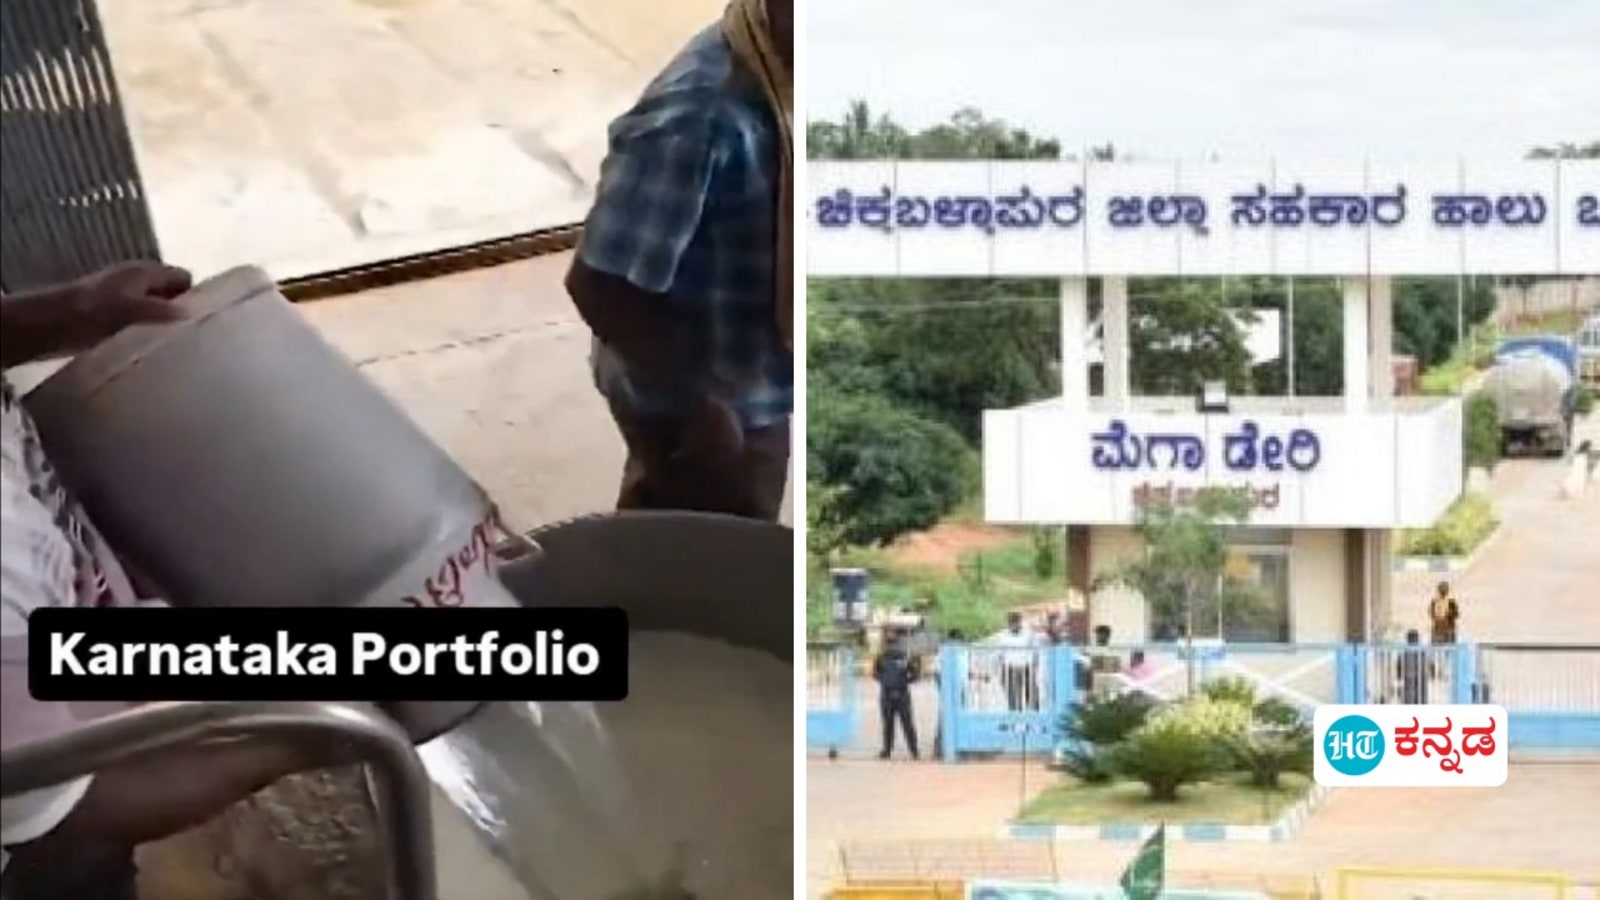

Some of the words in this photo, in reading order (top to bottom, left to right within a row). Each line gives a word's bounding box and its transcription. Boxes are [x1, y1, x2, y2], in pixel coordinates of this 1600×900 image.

[1231, 184, 1407, 227] ಸಹಕಾರ
[1431, 194, 1547, 227] ಹಾಲು
[1091, 419, 1206, 471] ಮೆಗಾ
[1223, 421, 1321, 472] ಡೇರಿ
